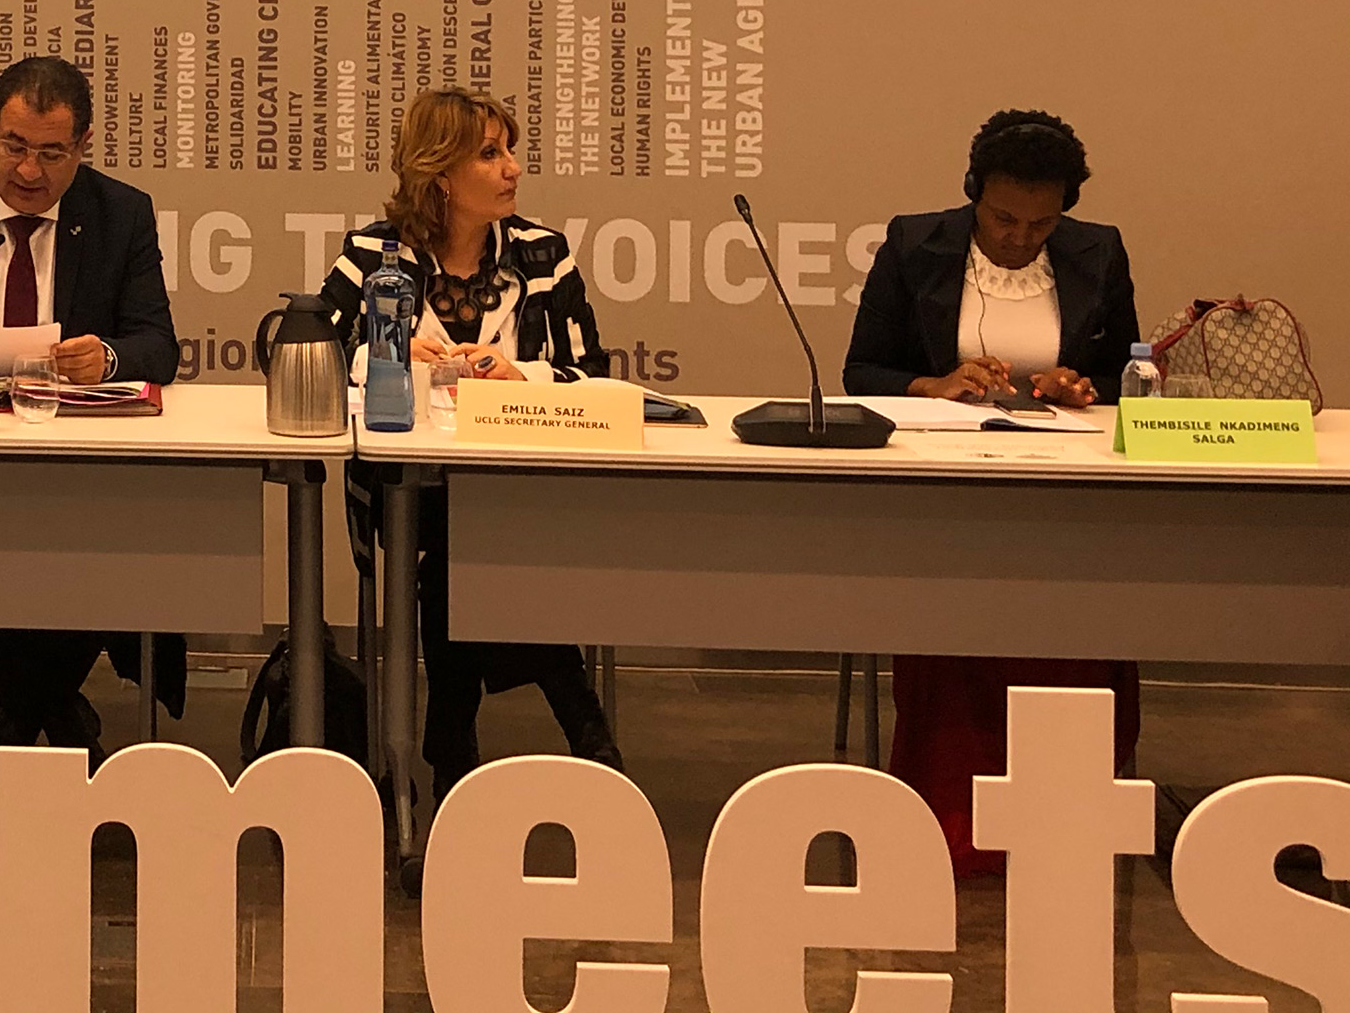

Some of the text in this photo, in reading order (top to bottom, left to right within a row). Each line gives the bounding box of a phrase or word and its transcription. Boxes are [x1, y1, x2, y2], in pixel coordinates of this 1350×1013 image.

[104, 33, 120, 168] EMPOWERMENT
[152, 25, 169, 170] LOCAL FINANCES
[176, 31, 196, 170] MONITORING
[205, 39, 221, 170] METROPOLITAN
[229, 56, 245, 171] SOLIDARIDAD
[256, 27, 279, 171] EDUCATING
[312, 5, 329, 172] URBAN INNOVATION
[387, 11, 407, 103] CLIMÁTICO
[580, 15, 602, 176] THE NETWORK
[611, 27, 627, 118] ECONOMIC
[634, 46, 652, 177] HUMAN RIGHTS
[700, 38, 728, 178] THE NEW
[287, 90, 304, 172] MOBILITY
[336, 59, 356, 172] LEARNING
[362, 89, 381, 173] SÉCURITÉ
[526, 64, 543, 175] DEMOCRATIE
[610, 120, 626, 177] LOCAL
[734, 62, 764, 178] URBAN
[474, 416, 611, 430] UCLG SECRETARY GENERAL
[501, 404, 585, 418] EMILIA SAIZ
[1131, 419, 1300, 433] THEMBISILE NKADIMENG
[1192, 434, 1235, 444] SALGA
